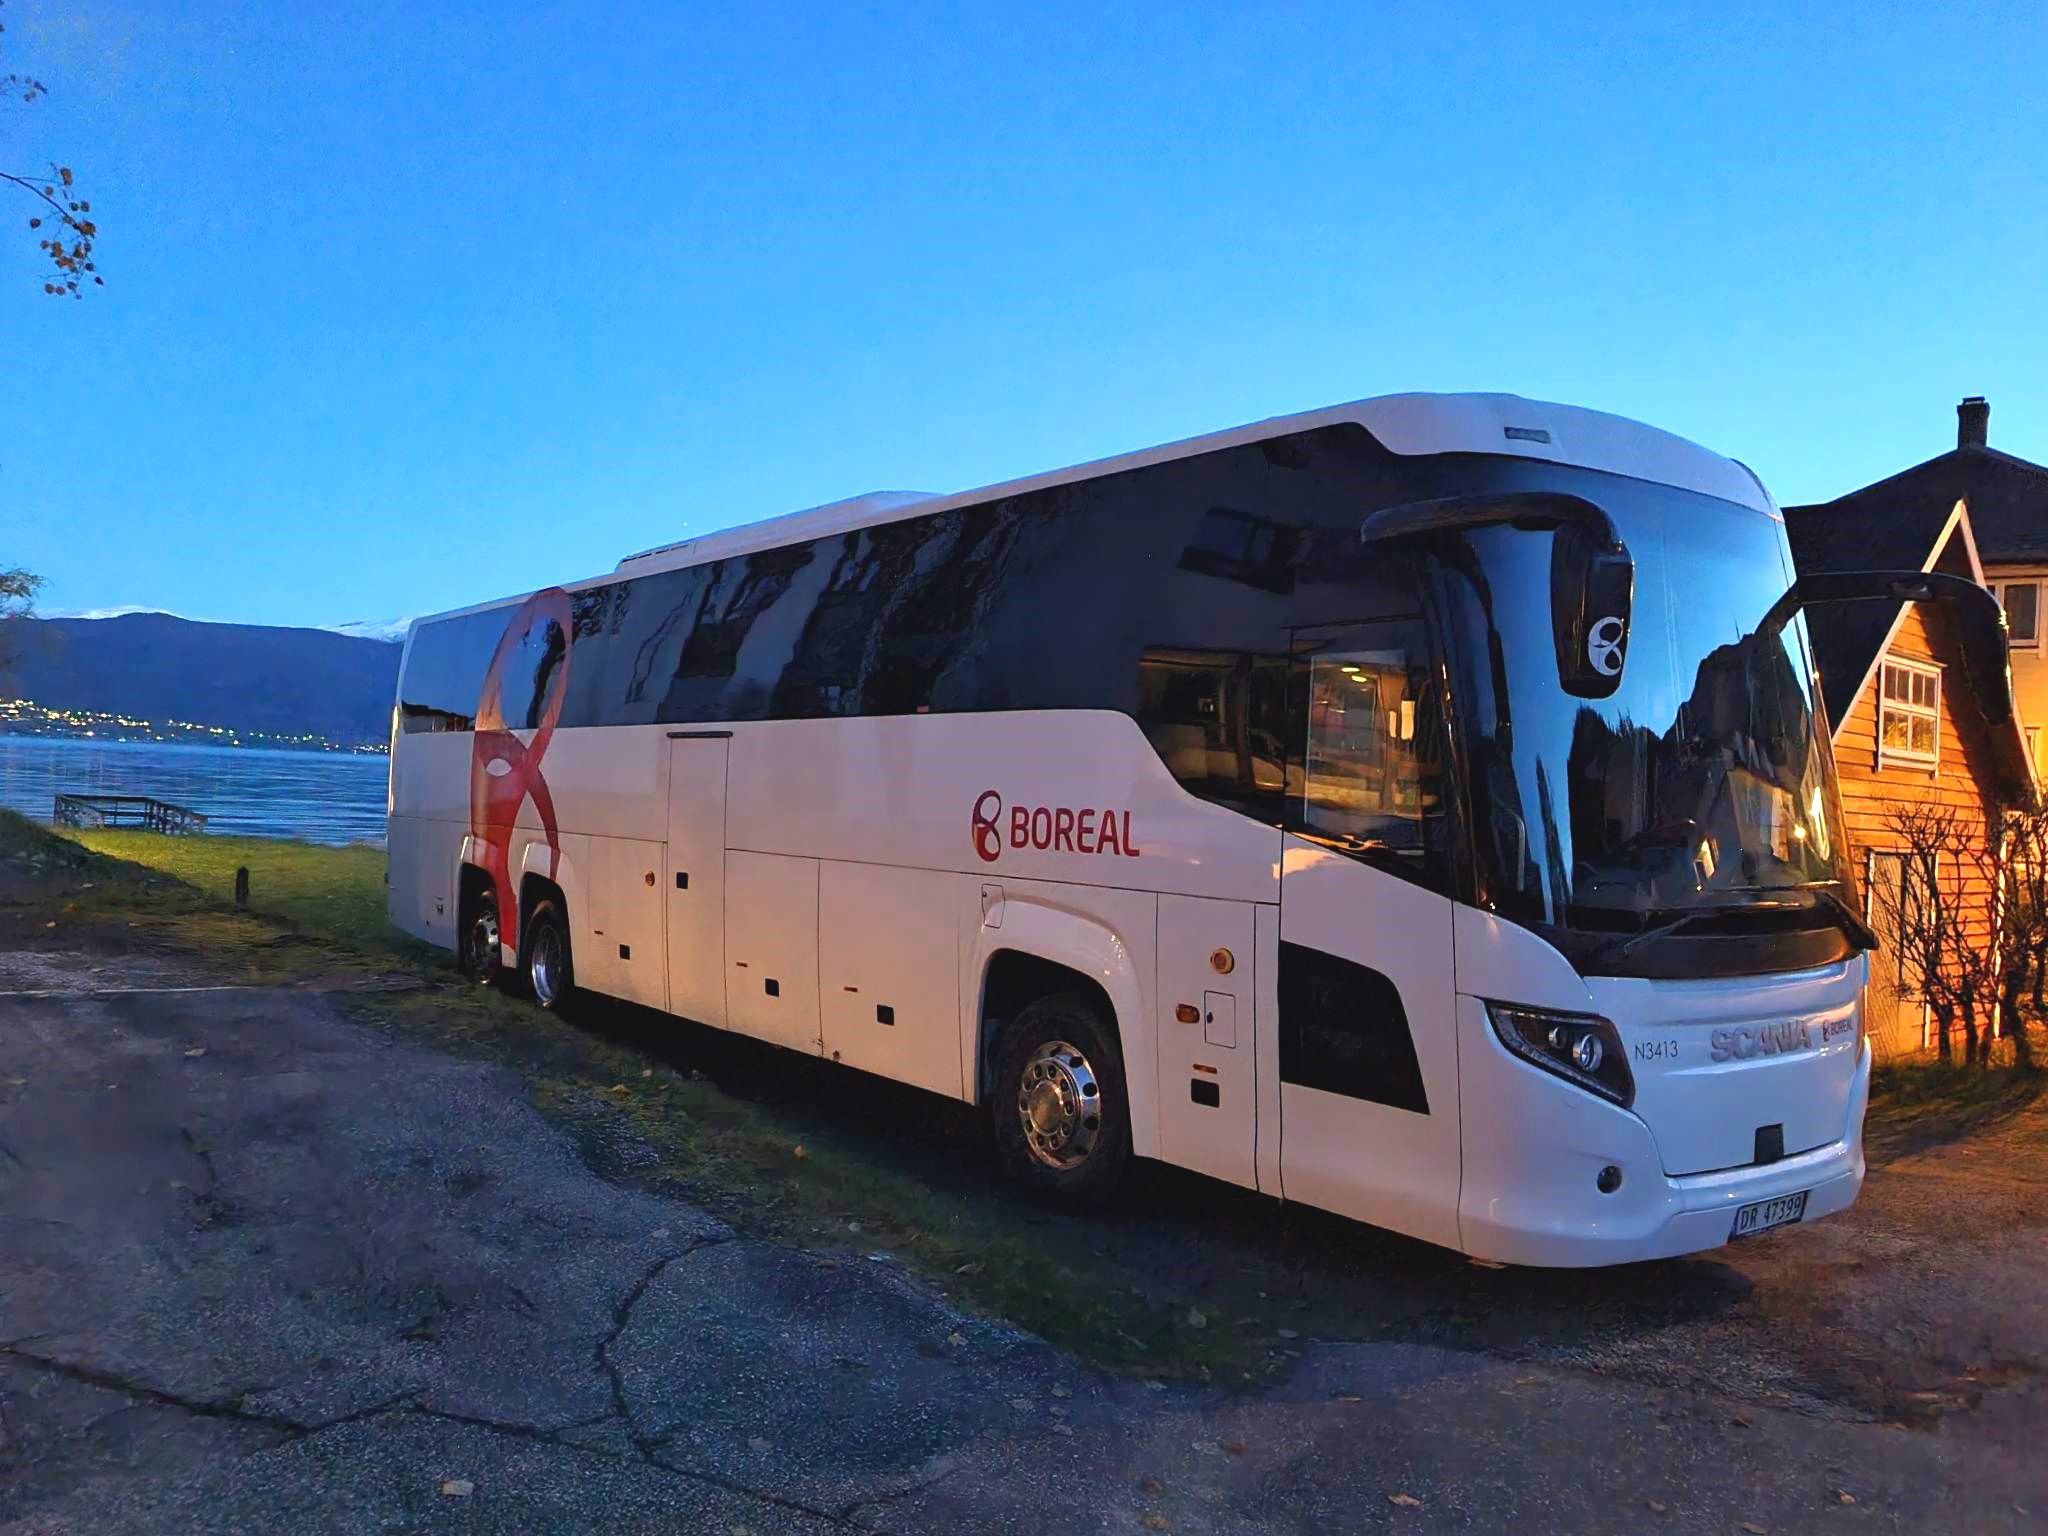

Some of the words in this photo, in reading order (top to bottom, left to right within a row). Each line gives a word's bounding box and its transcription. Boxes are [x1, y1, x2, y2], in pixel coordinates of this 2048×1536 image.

[1011, 806, 1140, 857] BOREAL
[1635, 1040, 1678, 1060] N3413
[1711, 1020, 1812, 1062] SCANIA
[1740, 1207, 1758, 1230] DR
[1763, 1196, 1801, 1223] 47399
